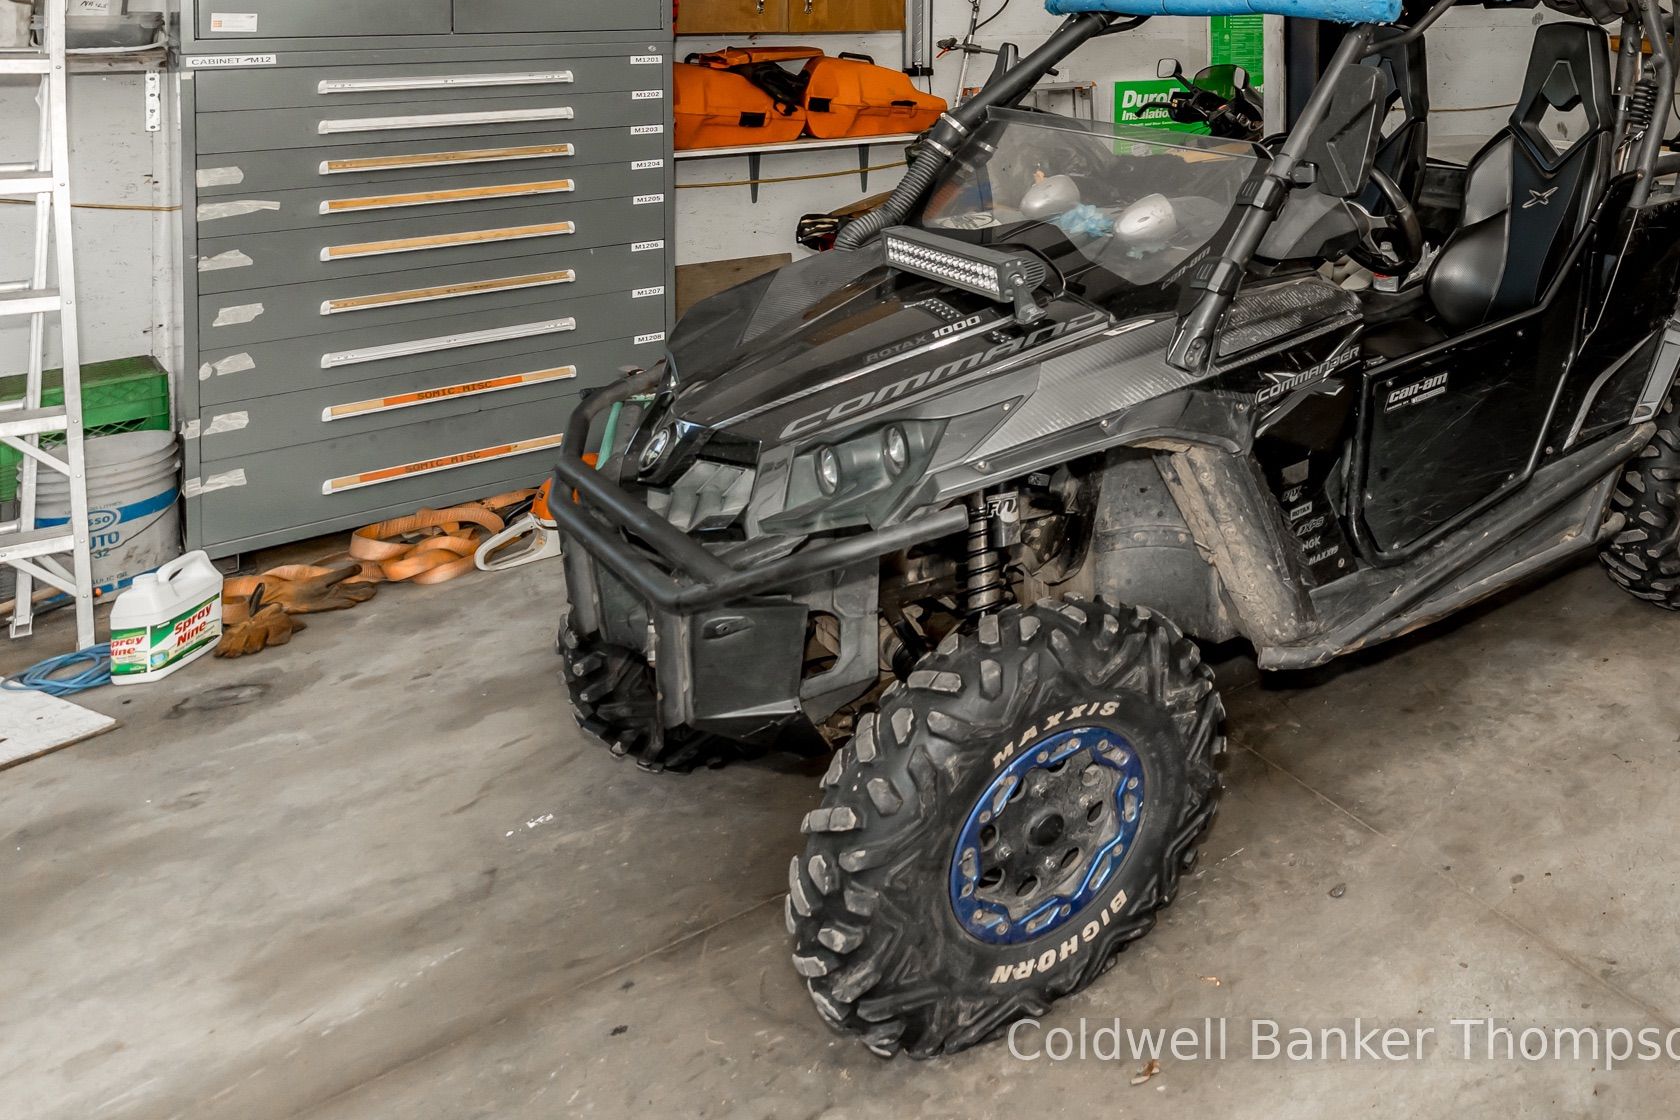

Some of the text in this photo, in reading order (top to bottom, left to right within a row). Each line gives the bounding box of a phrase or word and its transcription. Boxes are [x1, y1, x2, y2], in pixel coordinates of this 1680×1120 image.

[1122, 108, 1170, 120] Insulatio
[635, 242, 659, 250] M1206
[637, 288, 661, 296] M1207
[638, 334, 662, 342] M1208
[863, 315, 981, 363] ROTAX 1000
[1255, 346, 1360, 404] COMMANDER
[462, 381, 491, 392] MISC
[1389, 373, 1448, 403] can-am
[90, 530, 119, 548] UTO
[1302, 536, 1321, 551] NGK
[1308, 545, 1339, 566] MAXXIS
[174, 603, 212, 635] Spray
[111, 636, 144, 648] pray
[177, 621, 207, 647] Nine
[993, 701, 1120, 769] MAXXIS
[990, 889, 1128, 984] BIGHORN
